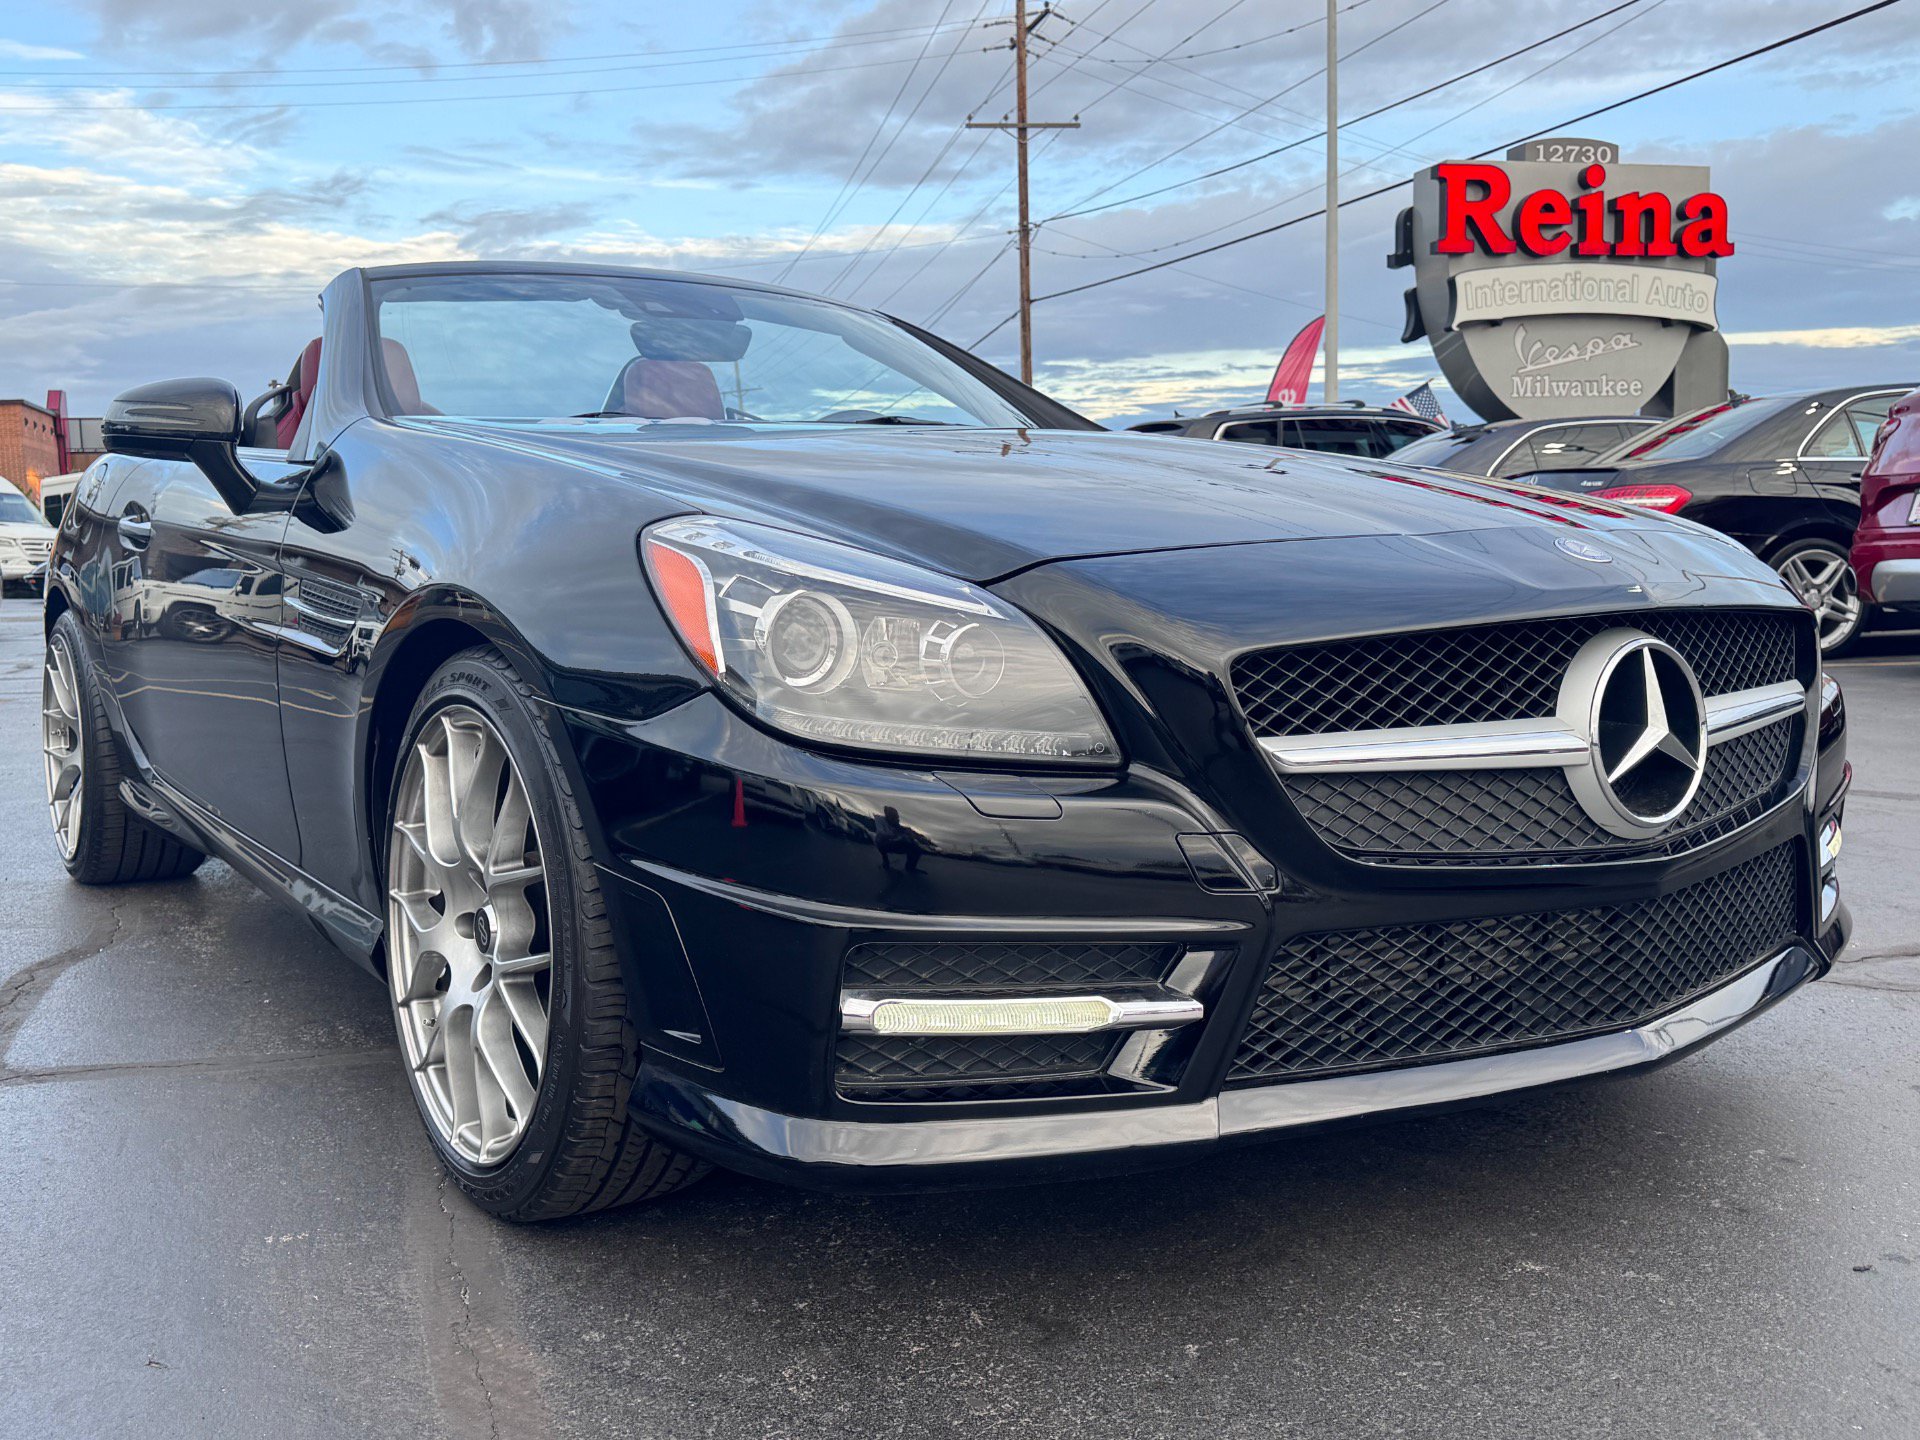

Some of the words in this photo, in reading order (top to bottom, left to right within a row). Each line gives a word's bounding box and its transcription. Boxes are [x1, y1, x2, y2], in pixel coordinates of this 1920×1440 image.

[1535, 144, 1612, 164] 12730
[1435, 163, 1735, 258] Reina
[1464, 271, 1640, 312] International
[1646, 276, 1710, 314] Auto
[1513, 323, 1642, 374] Vespa
[1511, 375, 1642, 399] Milwaukee
[449, 671, 492, 691] SPORT
